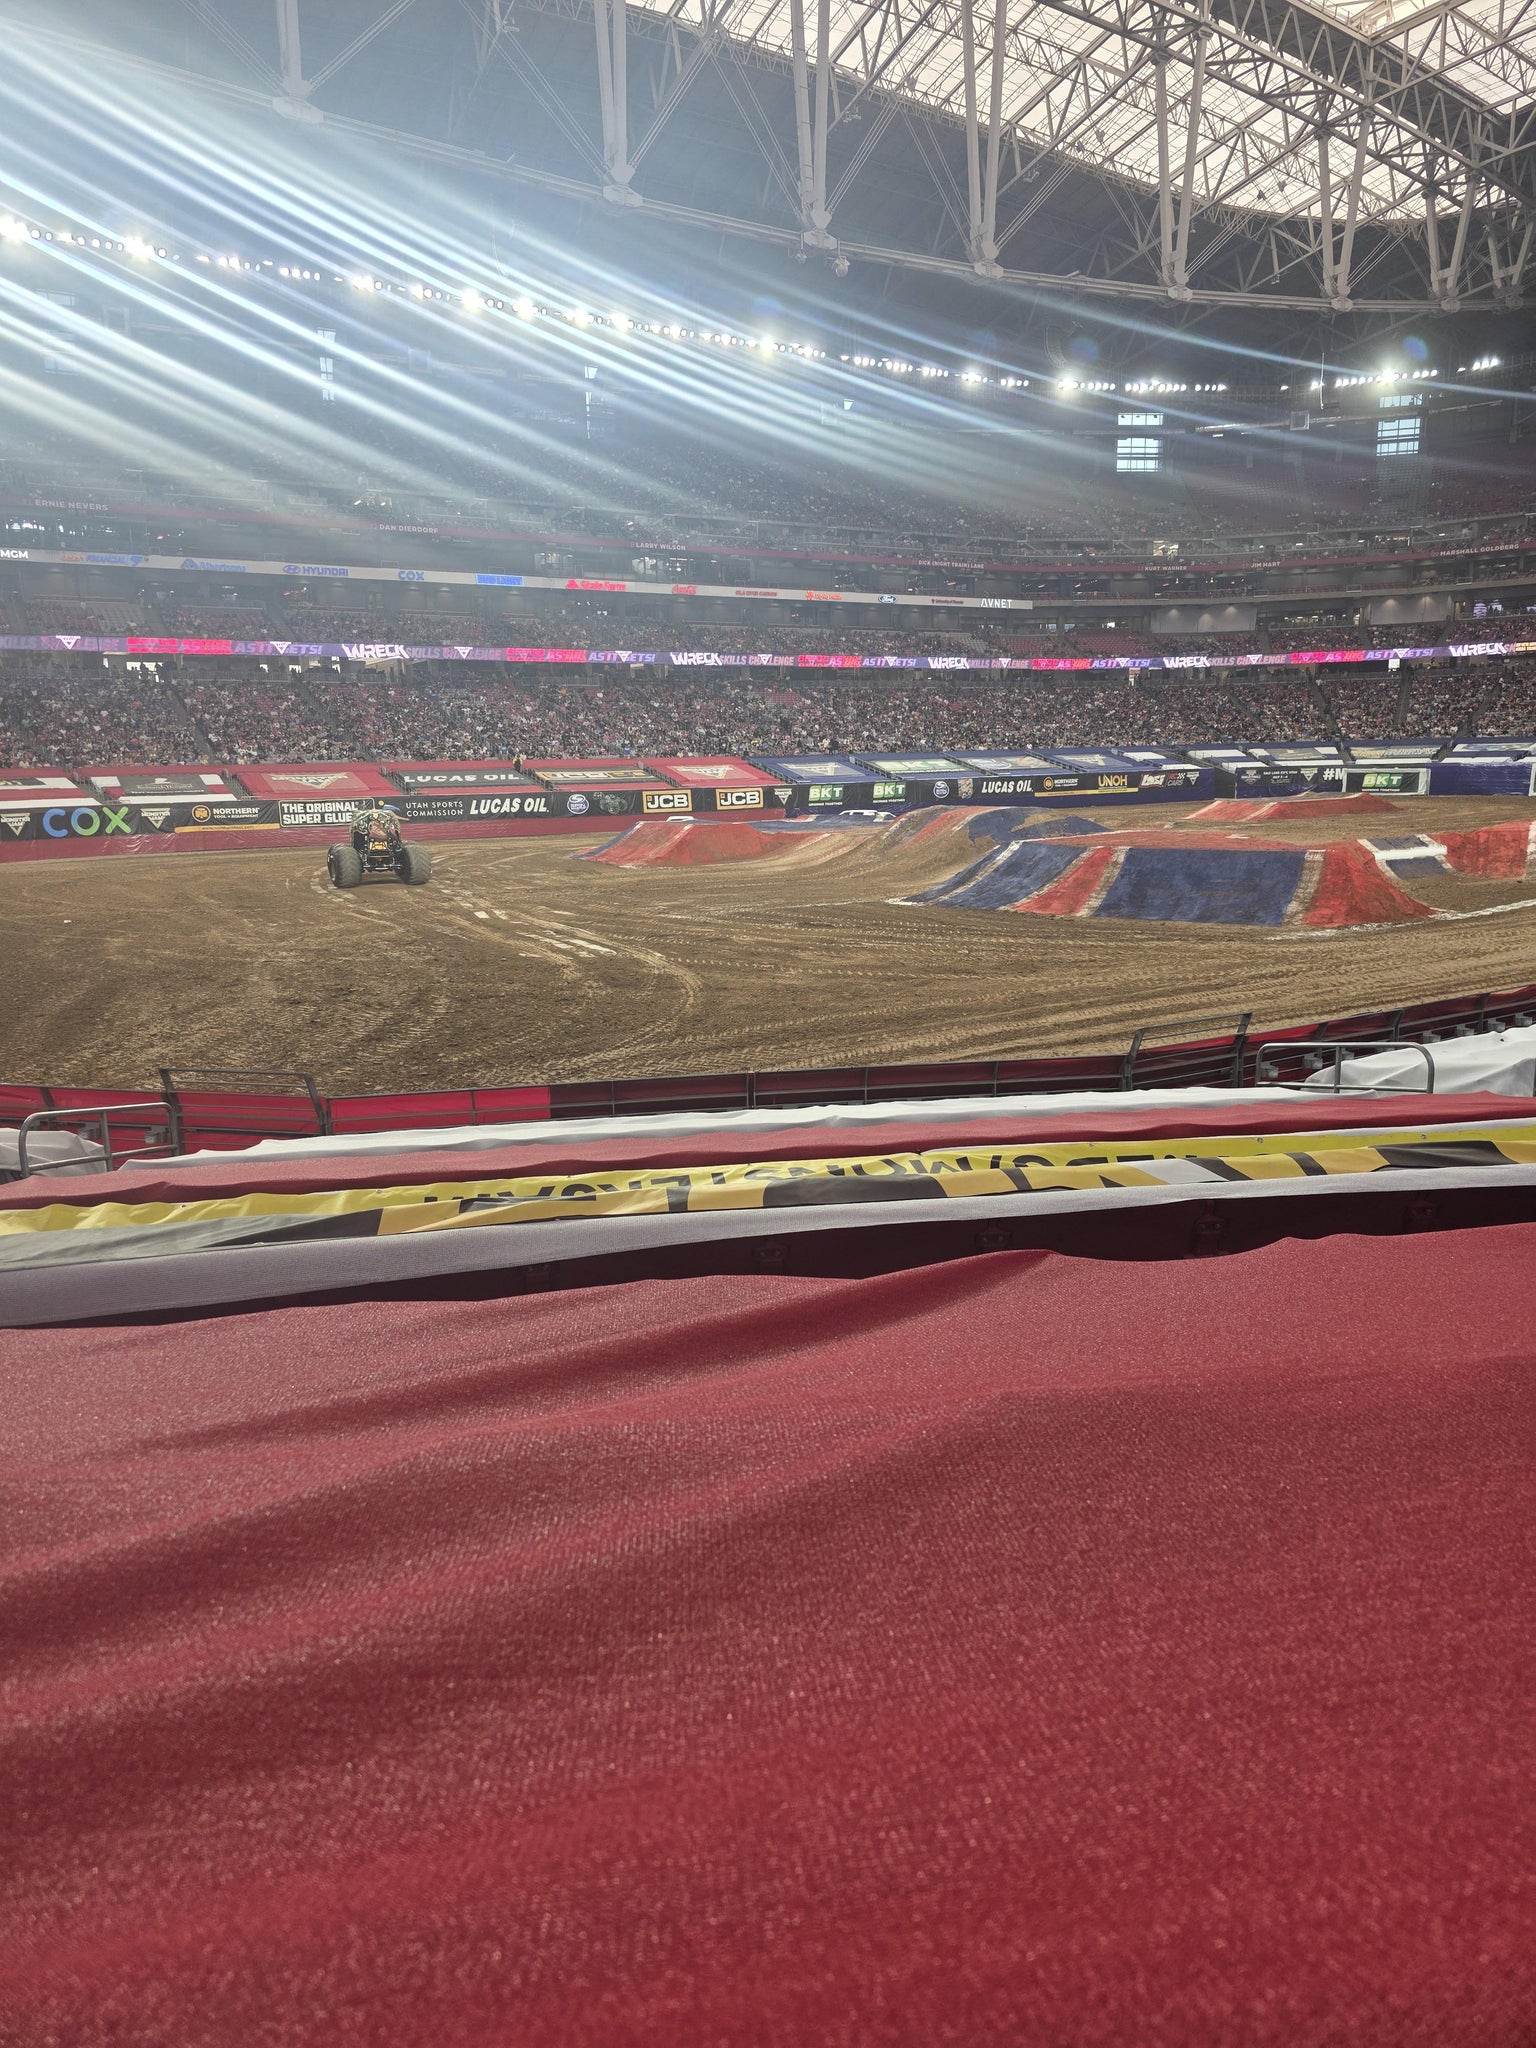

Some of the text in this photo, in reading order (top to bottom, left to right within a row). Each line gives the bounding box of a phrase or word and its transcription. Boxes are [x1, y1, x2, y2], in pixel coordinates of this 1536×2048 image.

[35, 499, 65, 508] ERNIE
[68, 502, 109, 511] NEVERS
[399, 525, 438, 534] DIERDORF
[660, 543, 686, 551] WILSON
[1439, 548, 1479, 556] MARSHALL
[1480, 543, 1520, 553] GOLDBERG
[301, 566, 349, 577] HYUNDAI
[397, 570, 425, 581] COX
[341, 643, 409, 659] WRECK
[1449, 642, 1507, 657] WRECK
[670, 652, 722, 666] WRECK
[720, 655, 747, 666] SKILLS
[927, 657, 970, 670] WRECK
[968, 659, 990, 669] SKILLS
[1163, 656, 1211, 669] WRECK
[1209, 657, 1236, 666] SKILLS
[404, 774, 477, 783] LUCAS
[1098, 775, 1128, 787] UNOH
[1362, 774, 1402, 788] BKT
[809, 786, 844, 801] BKT
[873, 783, 906, 798] BKT
[981, 781, 1015, 794] LUCAS
[647, 794, 688, 809] JCB
[720, 791, 760, 805] JCB
[213, 807, 259, 815] NORTHERN
[282, 802, 357, 813] THE ORIGINAL
[470, 798, 520, 815] LUCAS
[282, 812, 352, 824] SUPER GLUE
[406, 809, 464, 817] COMMISSION
[42, 806, 132, 838] COX
